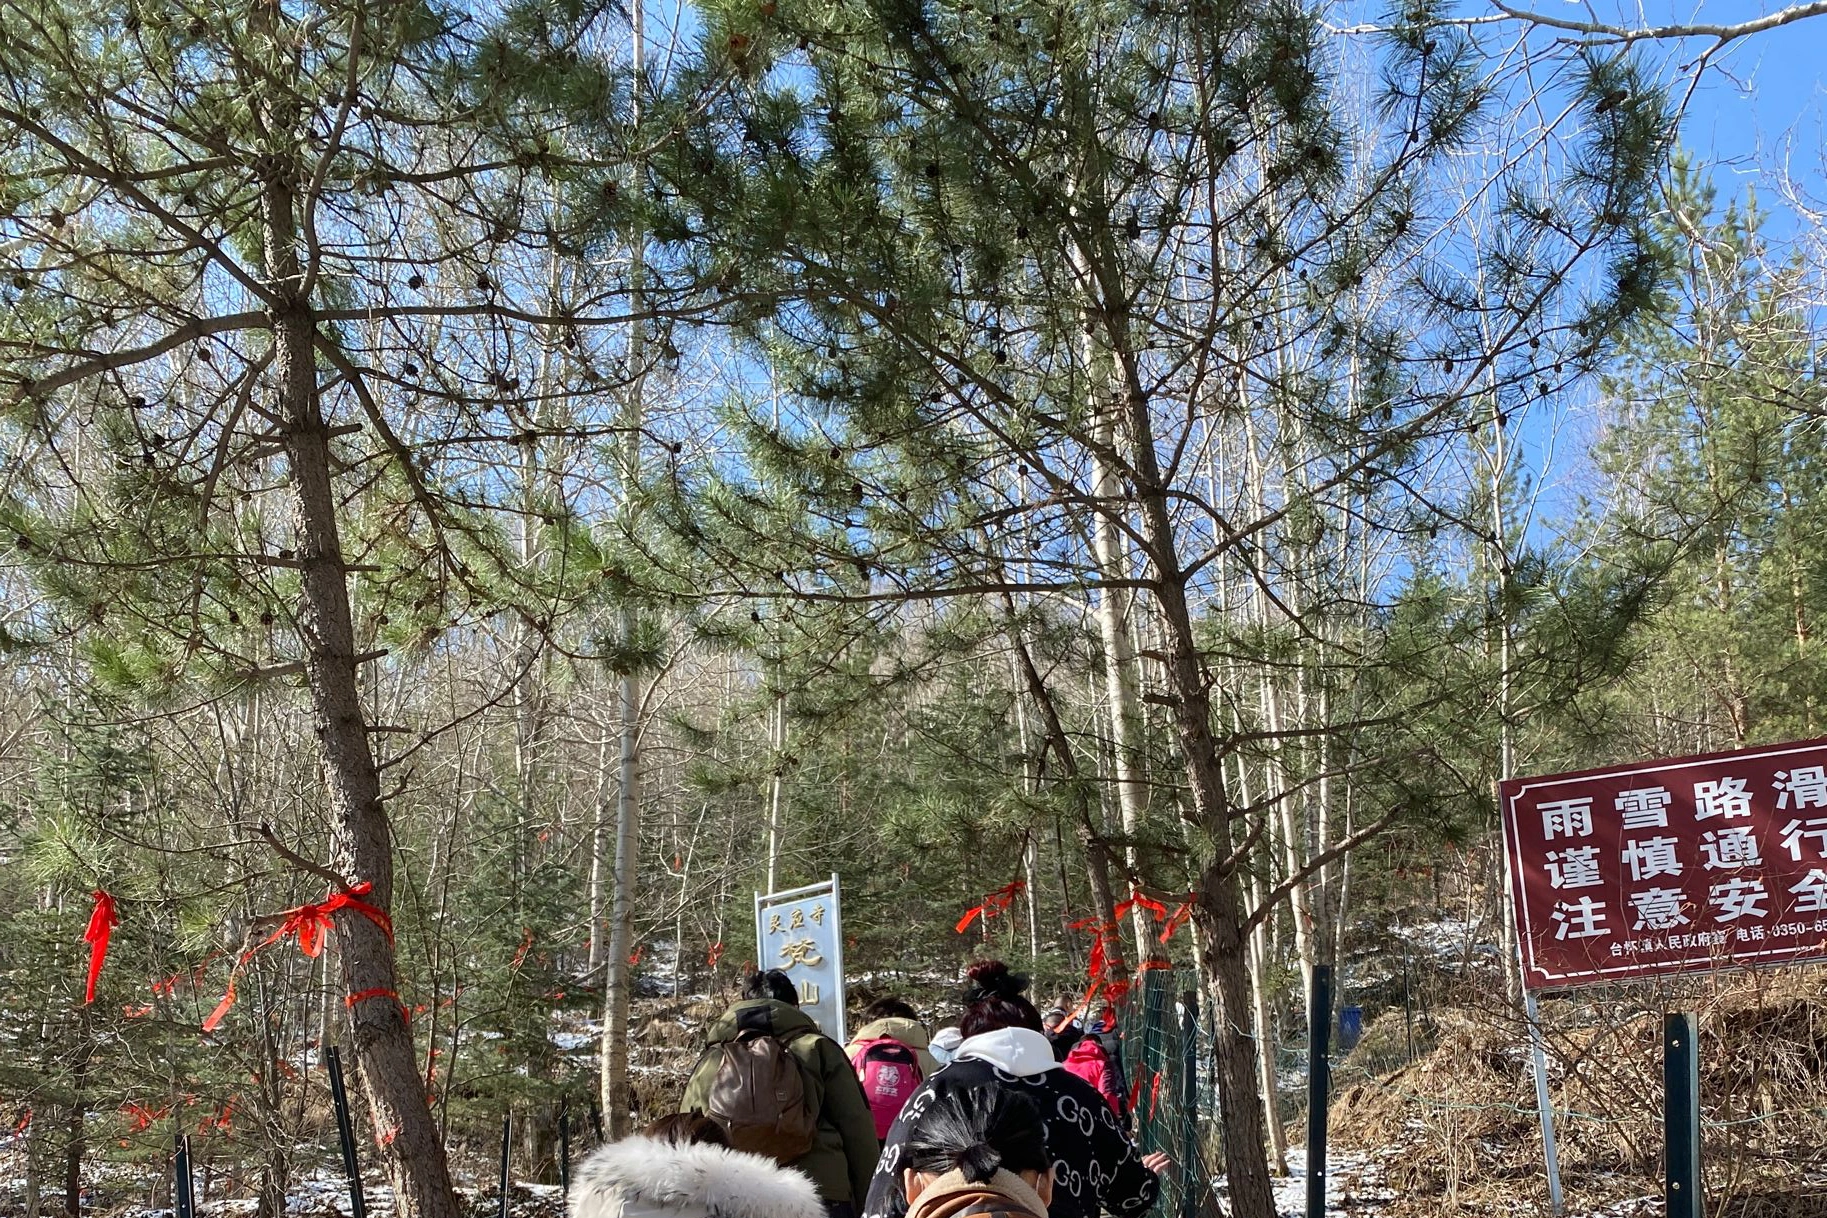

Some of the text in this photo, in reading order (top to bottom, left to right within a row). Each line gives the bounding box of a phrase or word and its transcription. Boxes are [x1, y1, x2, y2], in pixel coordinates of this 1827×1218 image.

[1536, 765, 1827, 840] 雨雪路滑
[1543, 817, 1827, 889] 谨慎通行
[1551, 868, 1827, 941] 注意安全
